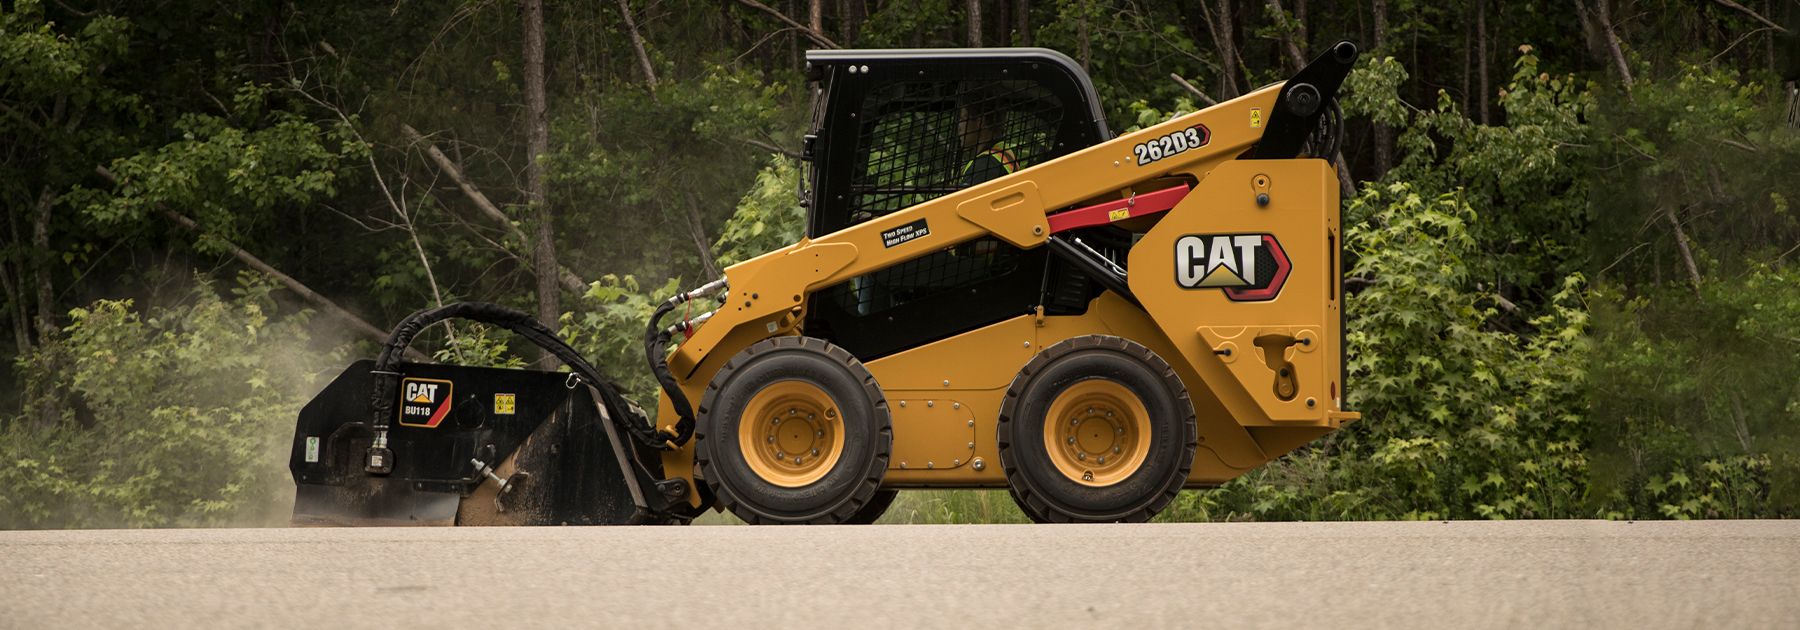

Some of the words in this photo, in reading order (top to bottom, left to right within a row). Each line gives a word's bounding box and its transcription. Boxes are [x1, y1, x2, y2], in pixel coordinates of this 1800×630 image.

[1134, 127, 1201, 165] 262D3
[915, 228, 928, 236] XPS
[1176, 234, 1262, 288] CAT
[406, 382, 438, 403] CAT
[404, 405, 431, 416] BU118
